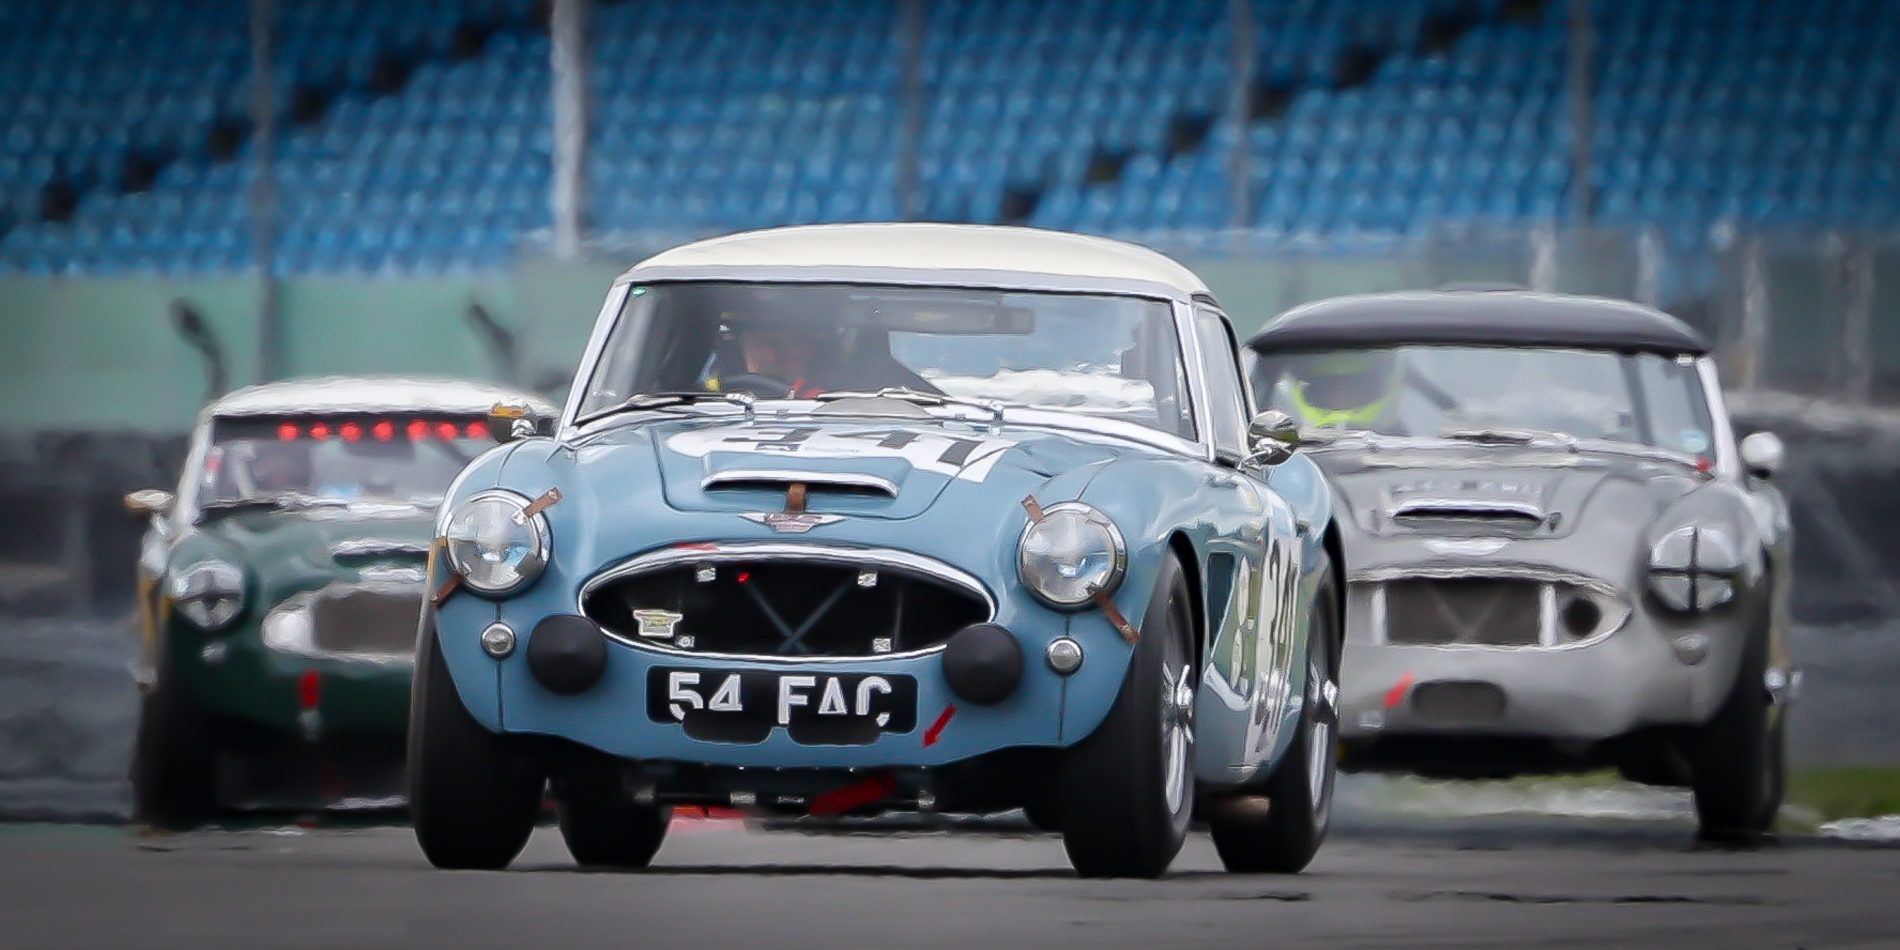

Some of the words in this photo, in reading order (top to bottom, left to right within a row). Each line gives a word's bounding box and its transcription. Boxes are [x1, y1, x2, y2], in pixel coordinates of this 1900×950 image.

[721, 425, 985, 467] 341
[669, 671, 743, 721] 54
[778, 675, 892, 727] FAC
